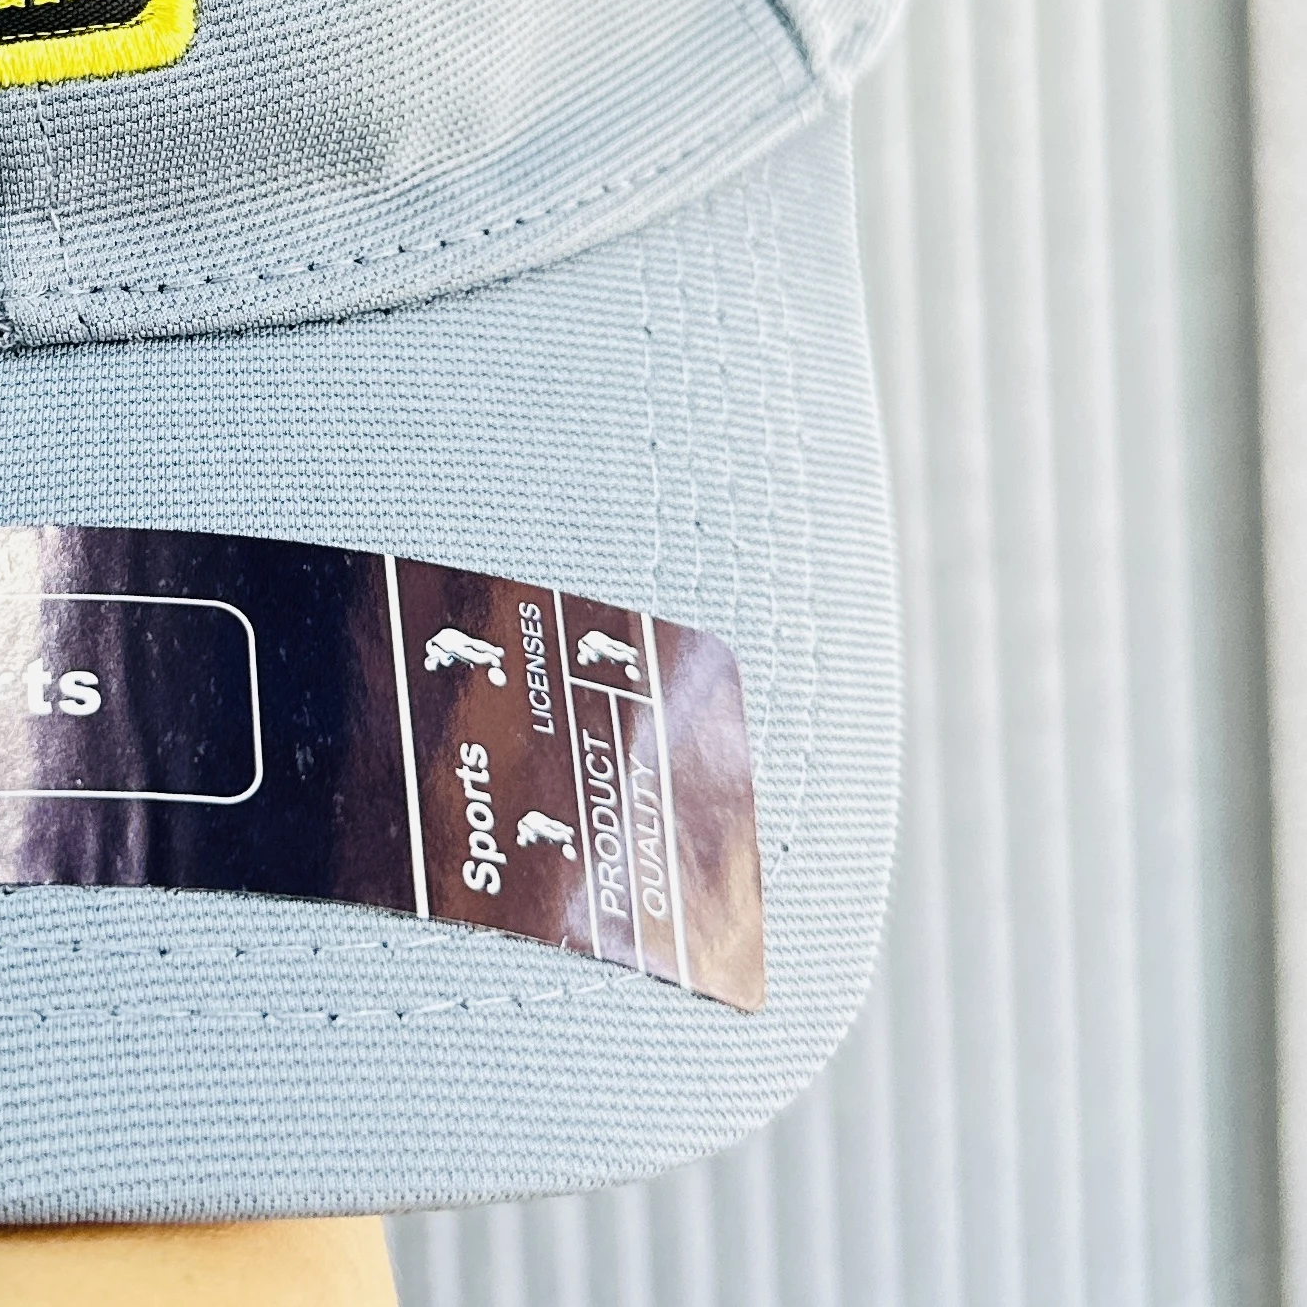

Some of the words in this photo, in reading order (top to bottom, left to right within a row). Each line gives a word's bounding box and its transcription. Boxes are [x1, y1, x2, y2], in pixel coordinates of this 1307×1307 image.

[518, 601, 556, 735] LICENSES
[455, 742, 507, 895] Sports
[583, 730, 628, 918] PRODUCT
[633, 755, 668, 917] QUALITY
